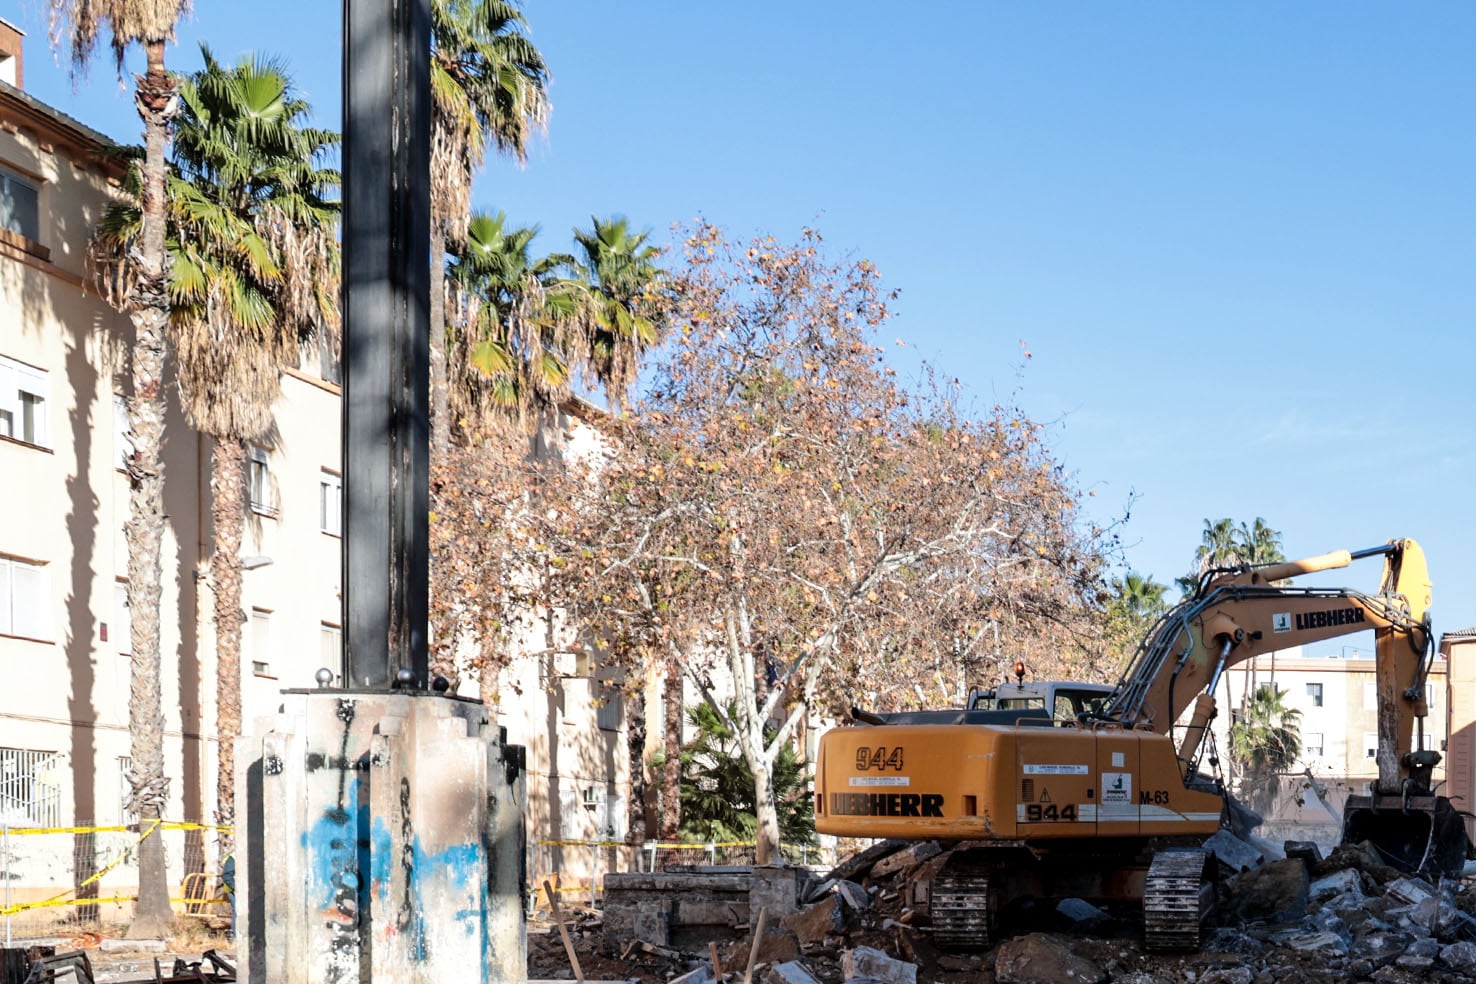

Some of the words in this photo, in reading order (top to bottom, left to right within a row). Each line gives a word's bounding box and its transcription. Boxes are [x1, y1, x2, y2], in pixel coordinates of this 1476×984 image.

[1296, 607, 1365, 630] LIEBHERR
[856, 746, 904, 771] 944
[830, 792, 944, 817] LIEBHERR
[1140, 791, 1169, 805] M-63
[1027, 804, 1077, 821] 944
